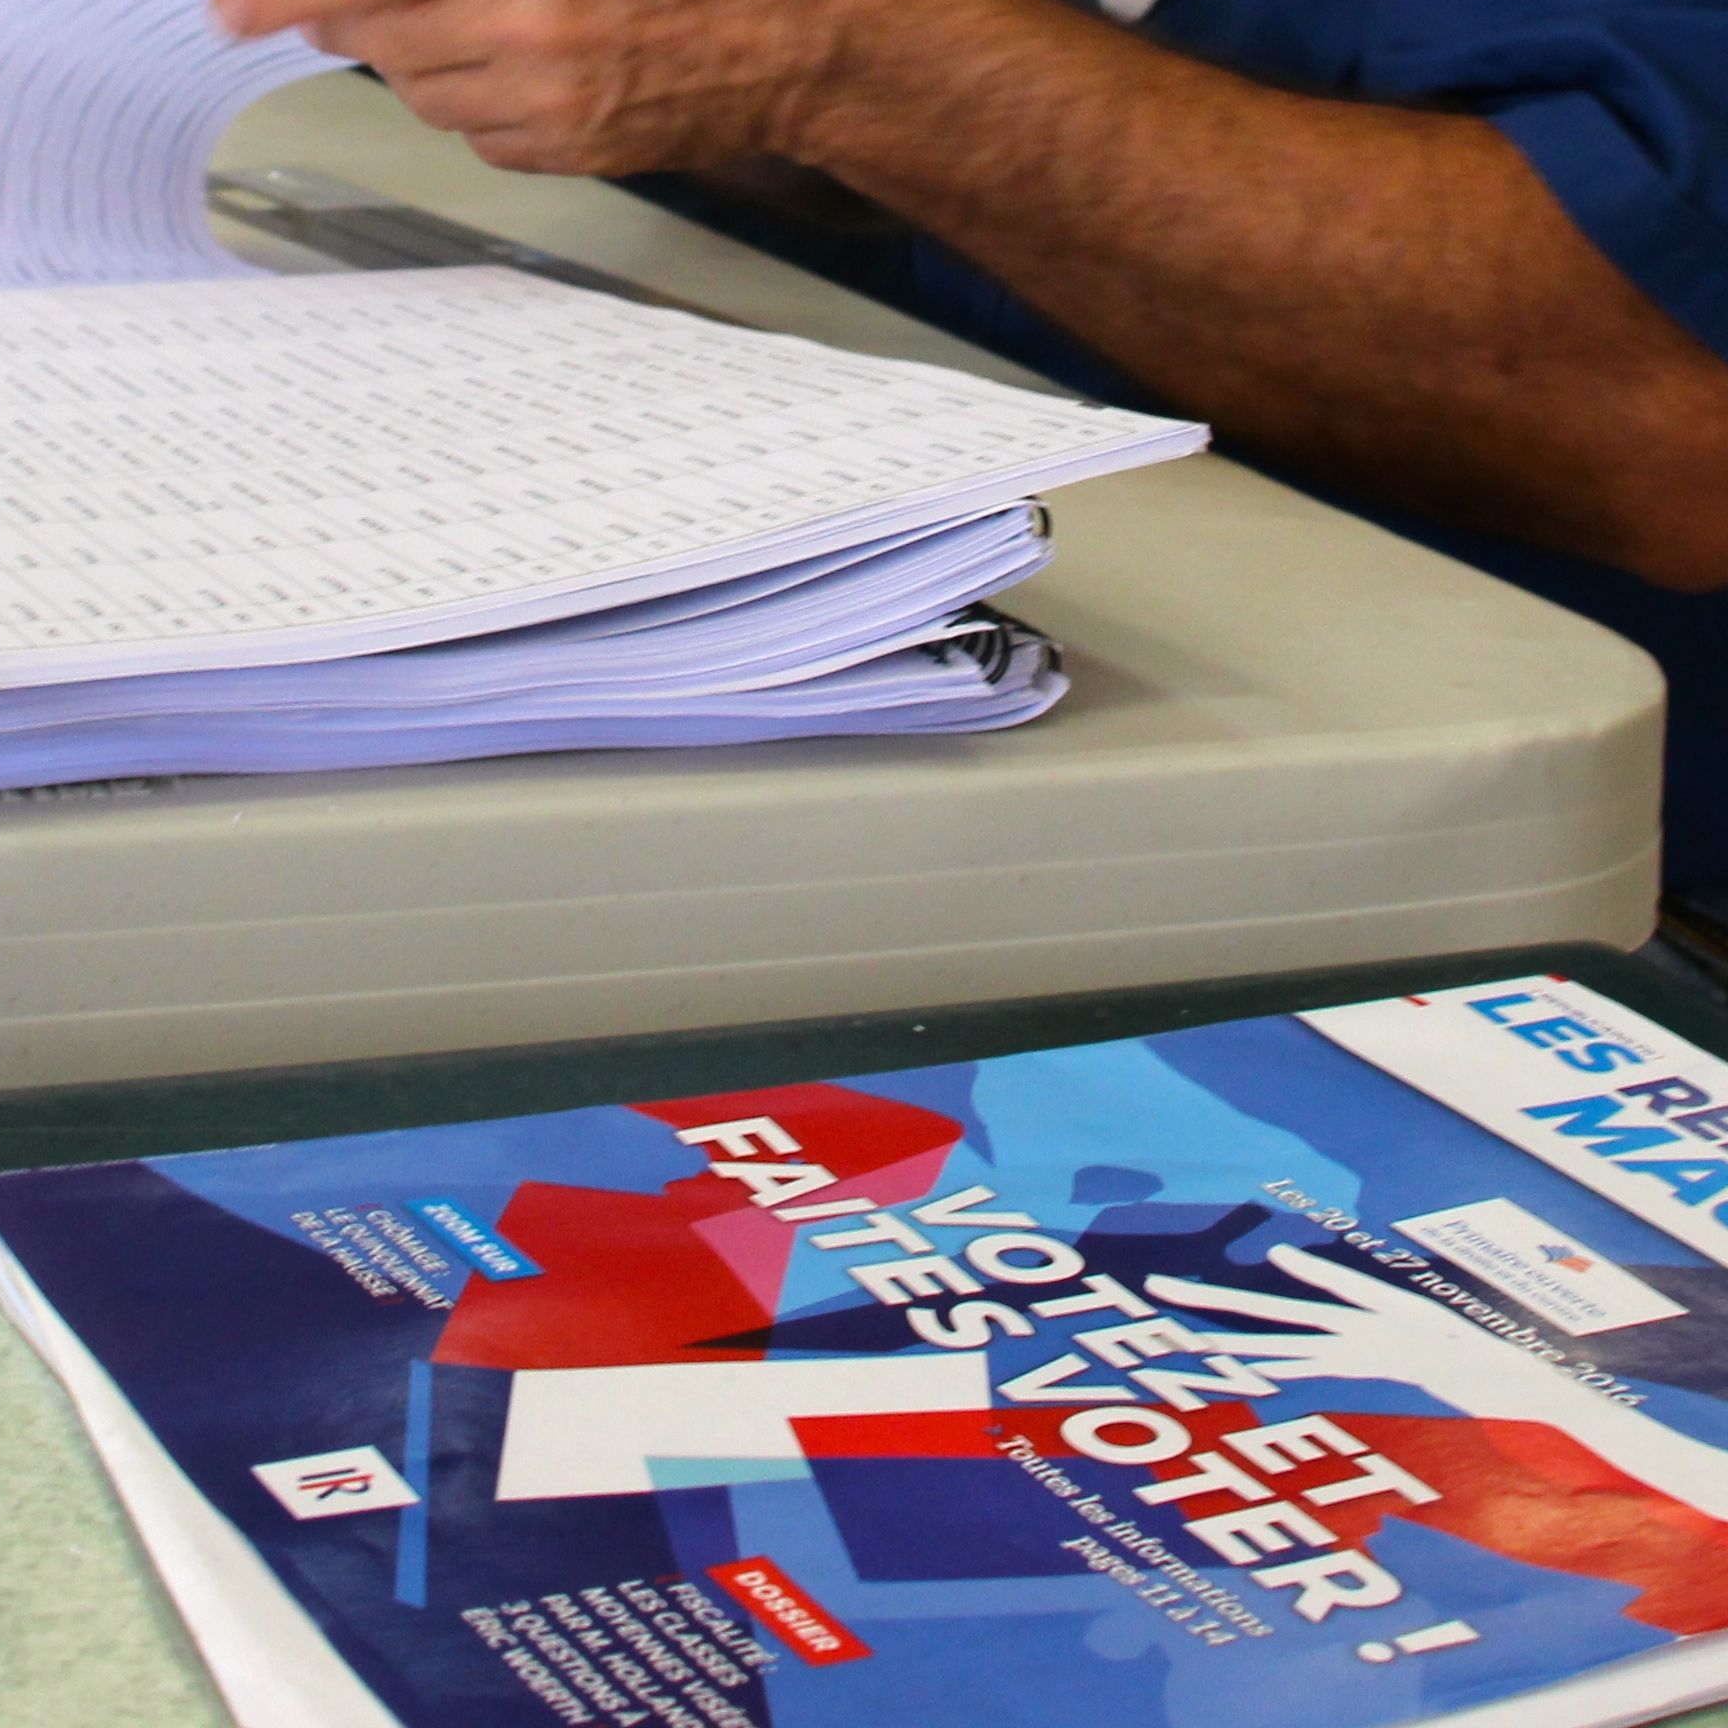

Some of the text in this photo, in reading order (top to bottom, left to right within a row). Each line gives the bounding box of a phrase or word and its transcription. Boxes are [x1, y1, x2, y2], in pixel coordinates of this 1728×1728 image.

[1465, 992, 1646, 1075] LES
[290, 1211, 399, 1298] DE LA HAUSSE
[324, 1207, 456, 1310] LE QUINQUENNAT
[423, 1203, 519, 1273] ZOOM SUR
[1262, 1176, 1649, 1410] Les 20 et 27 novembre 2016
[676, 1116, 1480, 1664] FAITES VOTER !
[912, 1185, 1443, 1511] VOTEZ ET
[996, 1434, 1274, 1639] Toutes les informations
[499, 1600, 531, 1617] 3
[539, 1592, 594, 1632] PAR
[580, 1586, 696, 1683] MOYENNES
[617, 1578, 750, 1688] LES CLASSES
[734, 1569, 842, 1653] DOSSIER
[1059, 1535, 1147, 1586] pages
[1136, 1583, 1184, 1608] 11
[1186, 1619, 1239, 1647] 14
[501, 1646, 594, 1727] WOERTH
[511, 1613, 631, 1713] QUESTIONS
